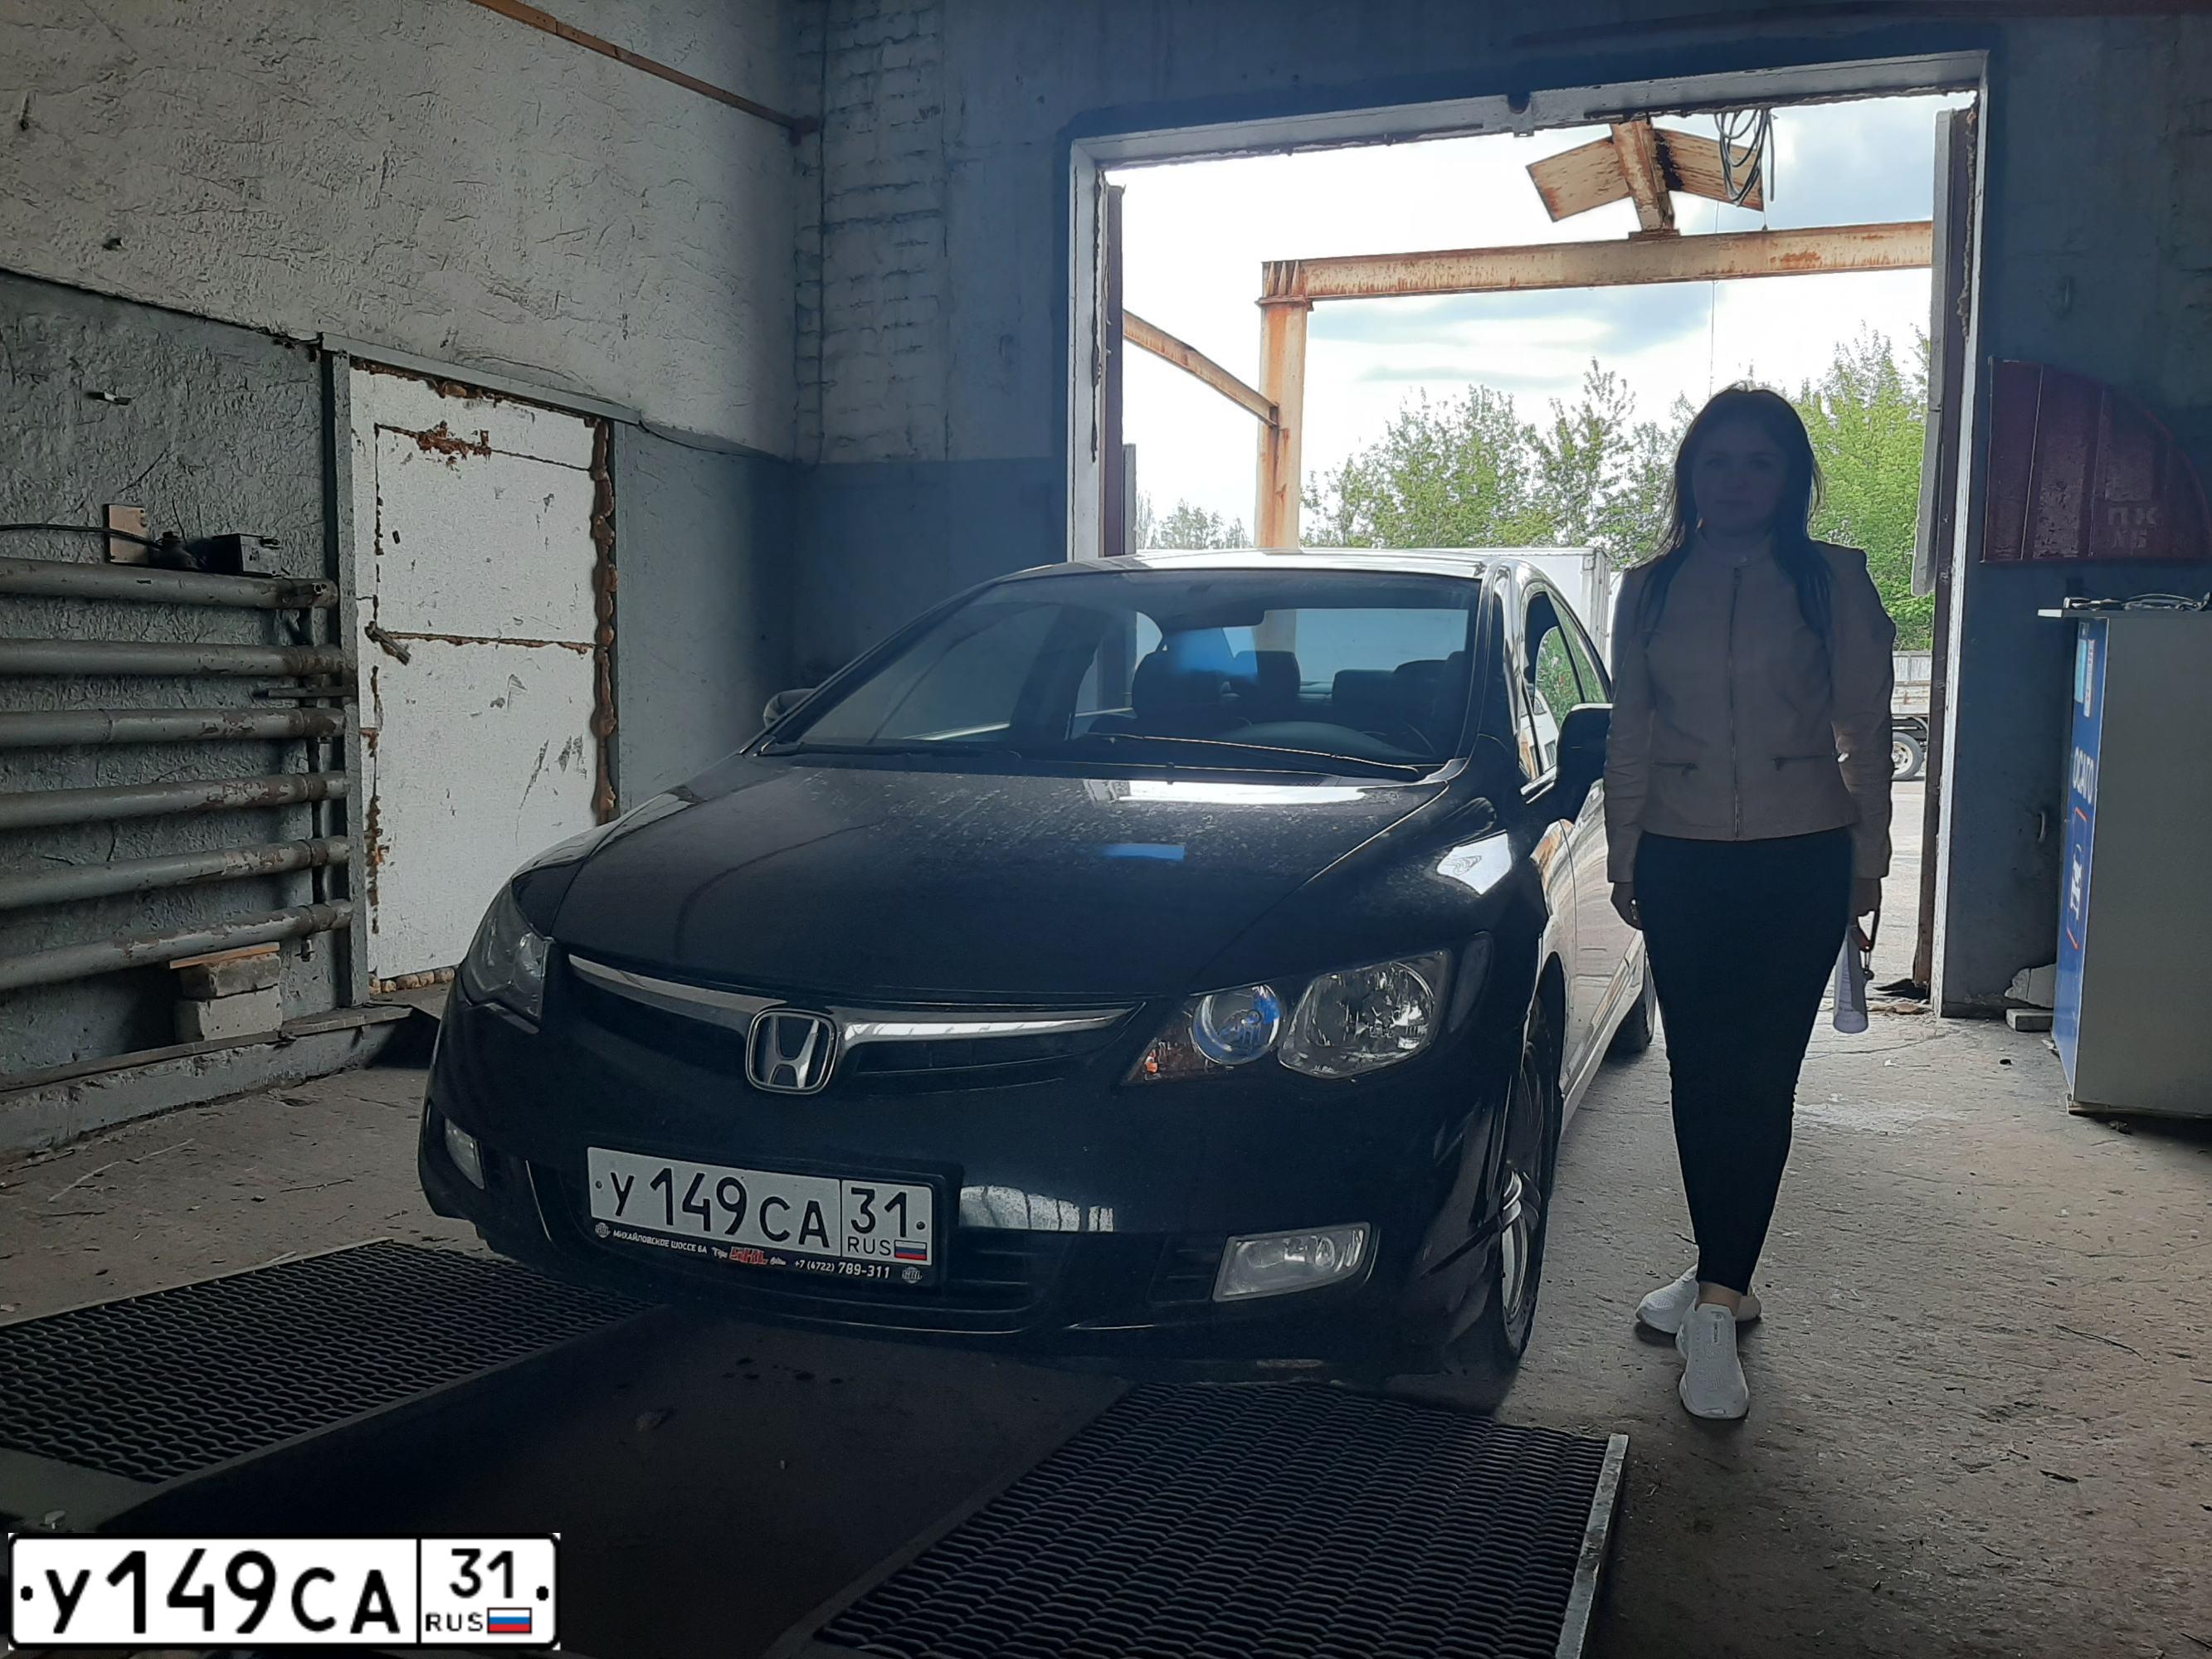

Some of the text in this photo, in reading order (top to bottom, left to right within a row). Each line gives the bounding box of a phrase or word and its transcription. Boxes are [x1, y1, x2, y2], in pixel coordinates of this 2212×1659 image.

[611, 1167, 908, 1248] У149СА 31
[670, 1240, 696, 1252] ШОССЕ
[847, 1238, 892, 1256] RUS
[795, 1259, 805, 1268] +7
[838, 1262, 890, 1279] 789-311
